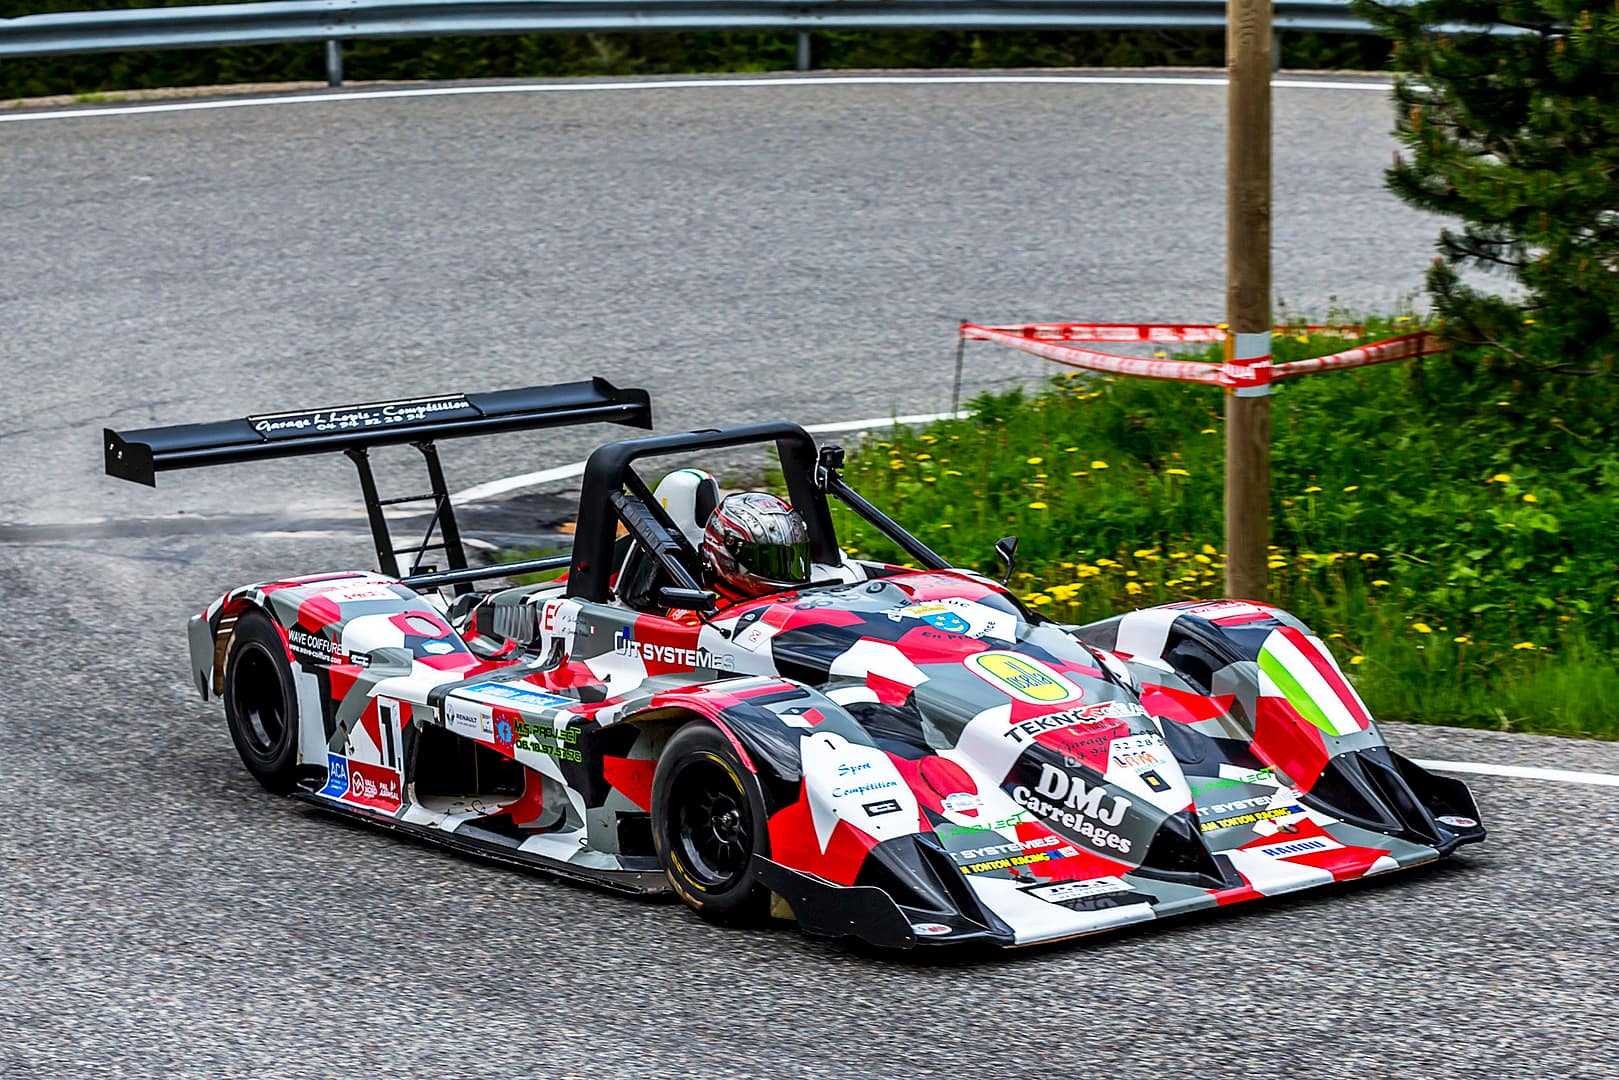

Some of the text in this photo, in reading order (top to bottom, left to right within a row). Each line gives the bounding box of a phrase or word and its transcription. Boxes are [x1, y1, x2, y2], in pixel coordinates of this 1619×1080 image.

[255, 419, 311, 432] Garage
[288, 628, 343, 656] WAVE COIFFURE
[643, 643, 735, 672] SYSTEMES
[330, 761, 347, 781] ACA
[837, 762, 872, 777] Sport
[1035, 763, 1132, 827] DMJ
[1217, 813, 1256, 829] TONTON
[1255, 807, 1292, 821] RACING
[960, 835, 1061, 860] SYSTEMES
[970, 858, 1012, 874] TONTON
[1012, 851, 1051, 867] RACING
